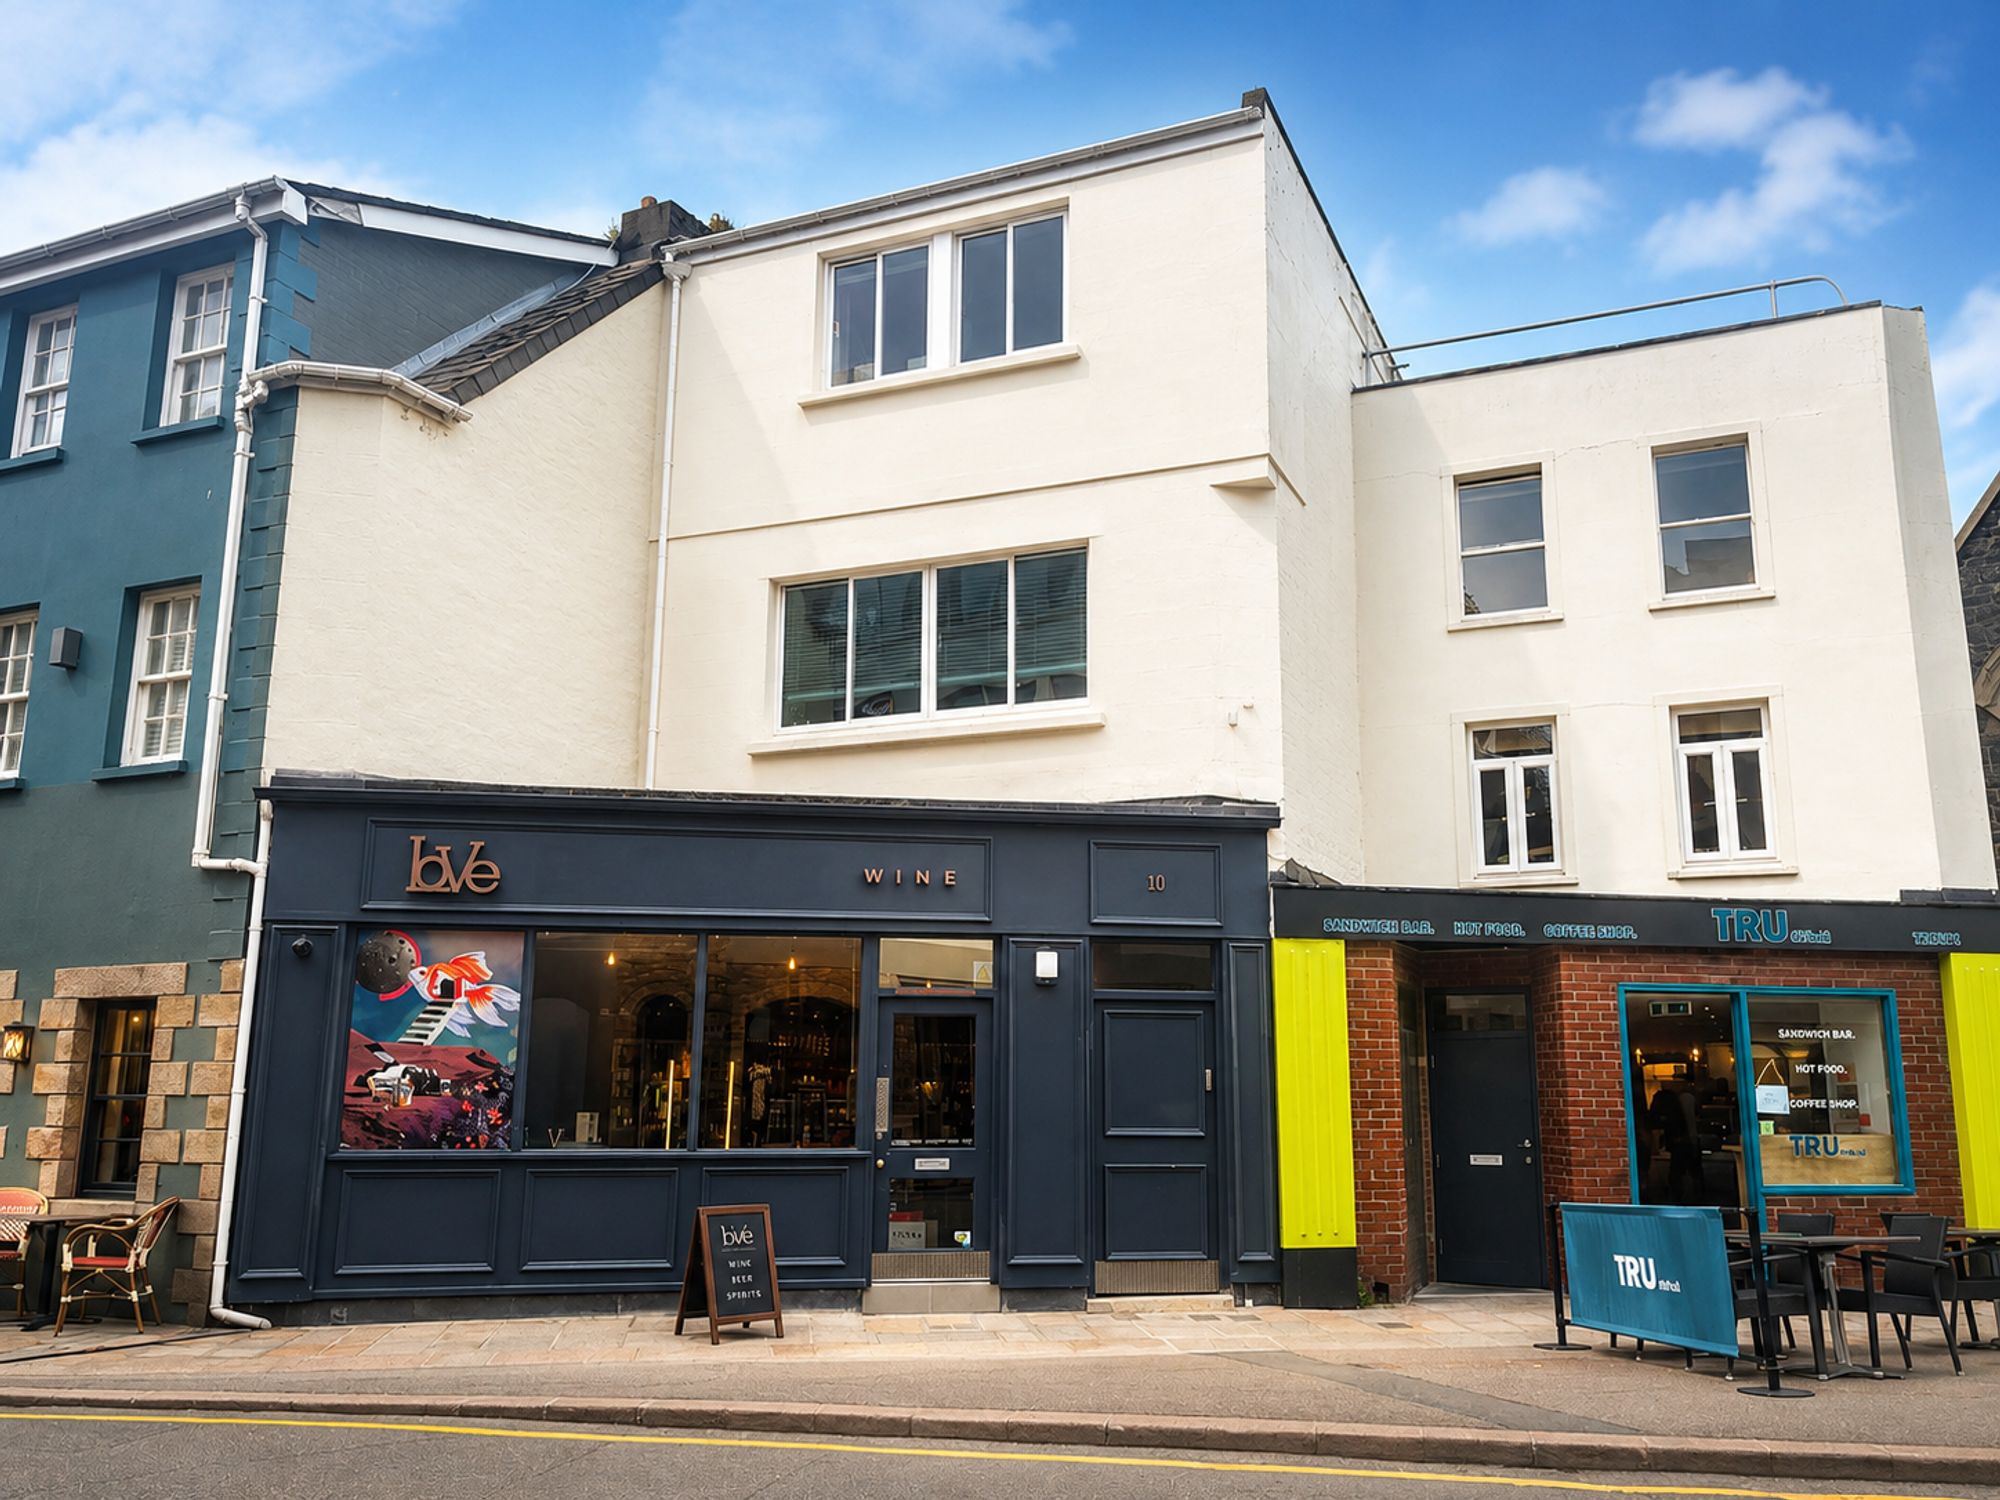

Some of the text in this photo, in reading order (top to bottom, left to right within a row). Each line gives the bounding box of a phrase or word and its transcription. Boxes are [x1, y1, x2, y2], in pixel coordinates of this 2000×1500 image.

[863, 868, 957, 886] WINE
[1147, 874, 1166, 891] 10
[1323, 918, 1399, 934] SANDWICH
[1711, 908, 1789, 944] TRU
[1778, 1028, 1831, 1040] SANDWICH
[1795, 1064, 1815, 1074] HOT
[1790, 1099, 1828, 1109] COFFEE
[1788, 1135, 1840, 1157] TRU
[728, 1259, 752, 1269] WINE
[1613, 1254, 1657, 1290] TRU
[731, 1275, 753, 1285] BEER
[726, 1290, 762, 1301] SPIRITS
